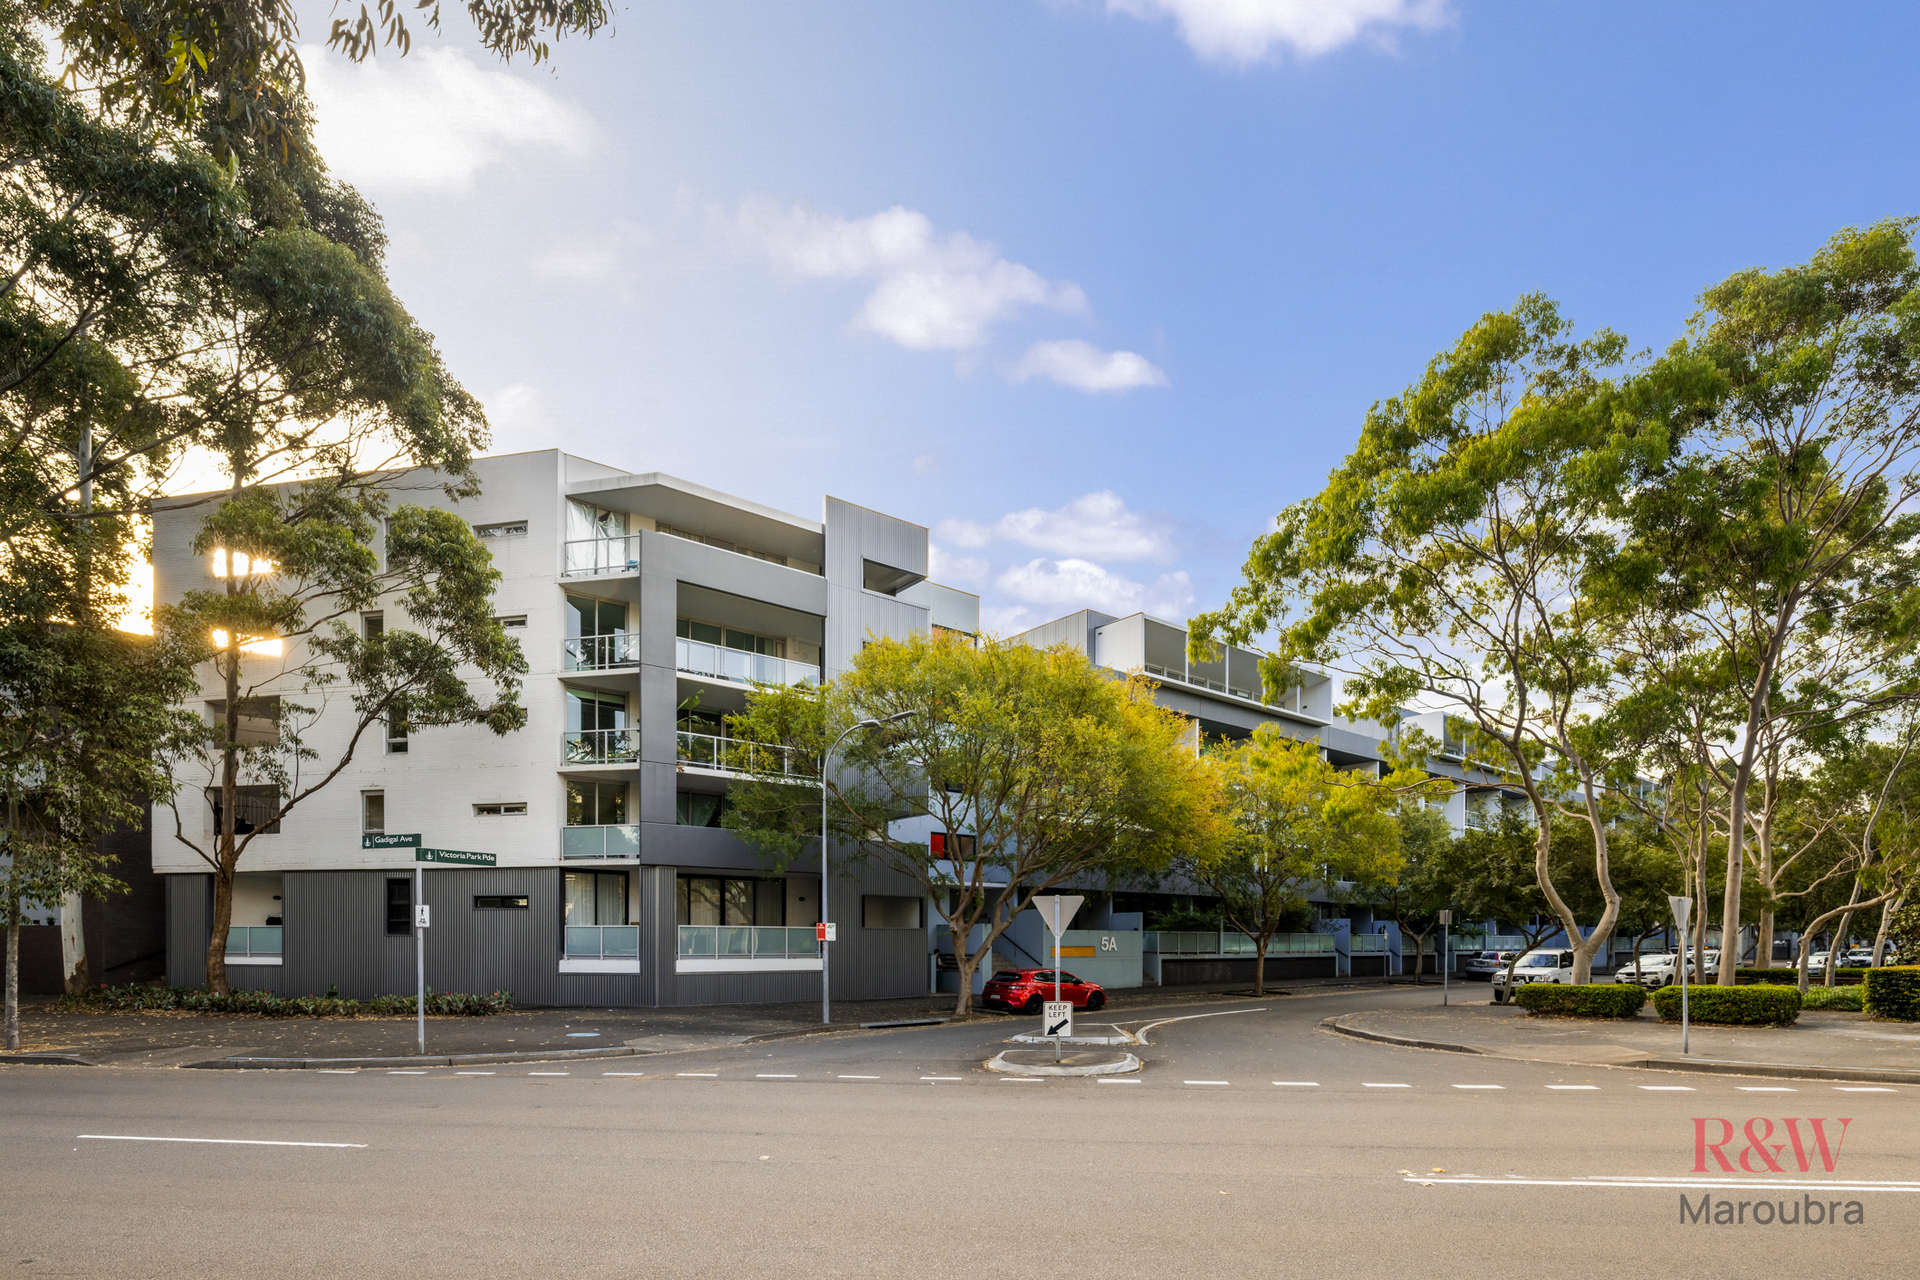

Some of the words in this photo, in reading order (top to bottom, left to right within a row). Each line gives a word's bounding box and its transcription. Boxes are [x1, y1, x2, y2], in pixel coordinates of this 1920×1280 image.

[374, 835, 399, 844] Gadigal
[438, 850, 466, 859] Victoria
[1100, 936, 1118, 951] 5A
